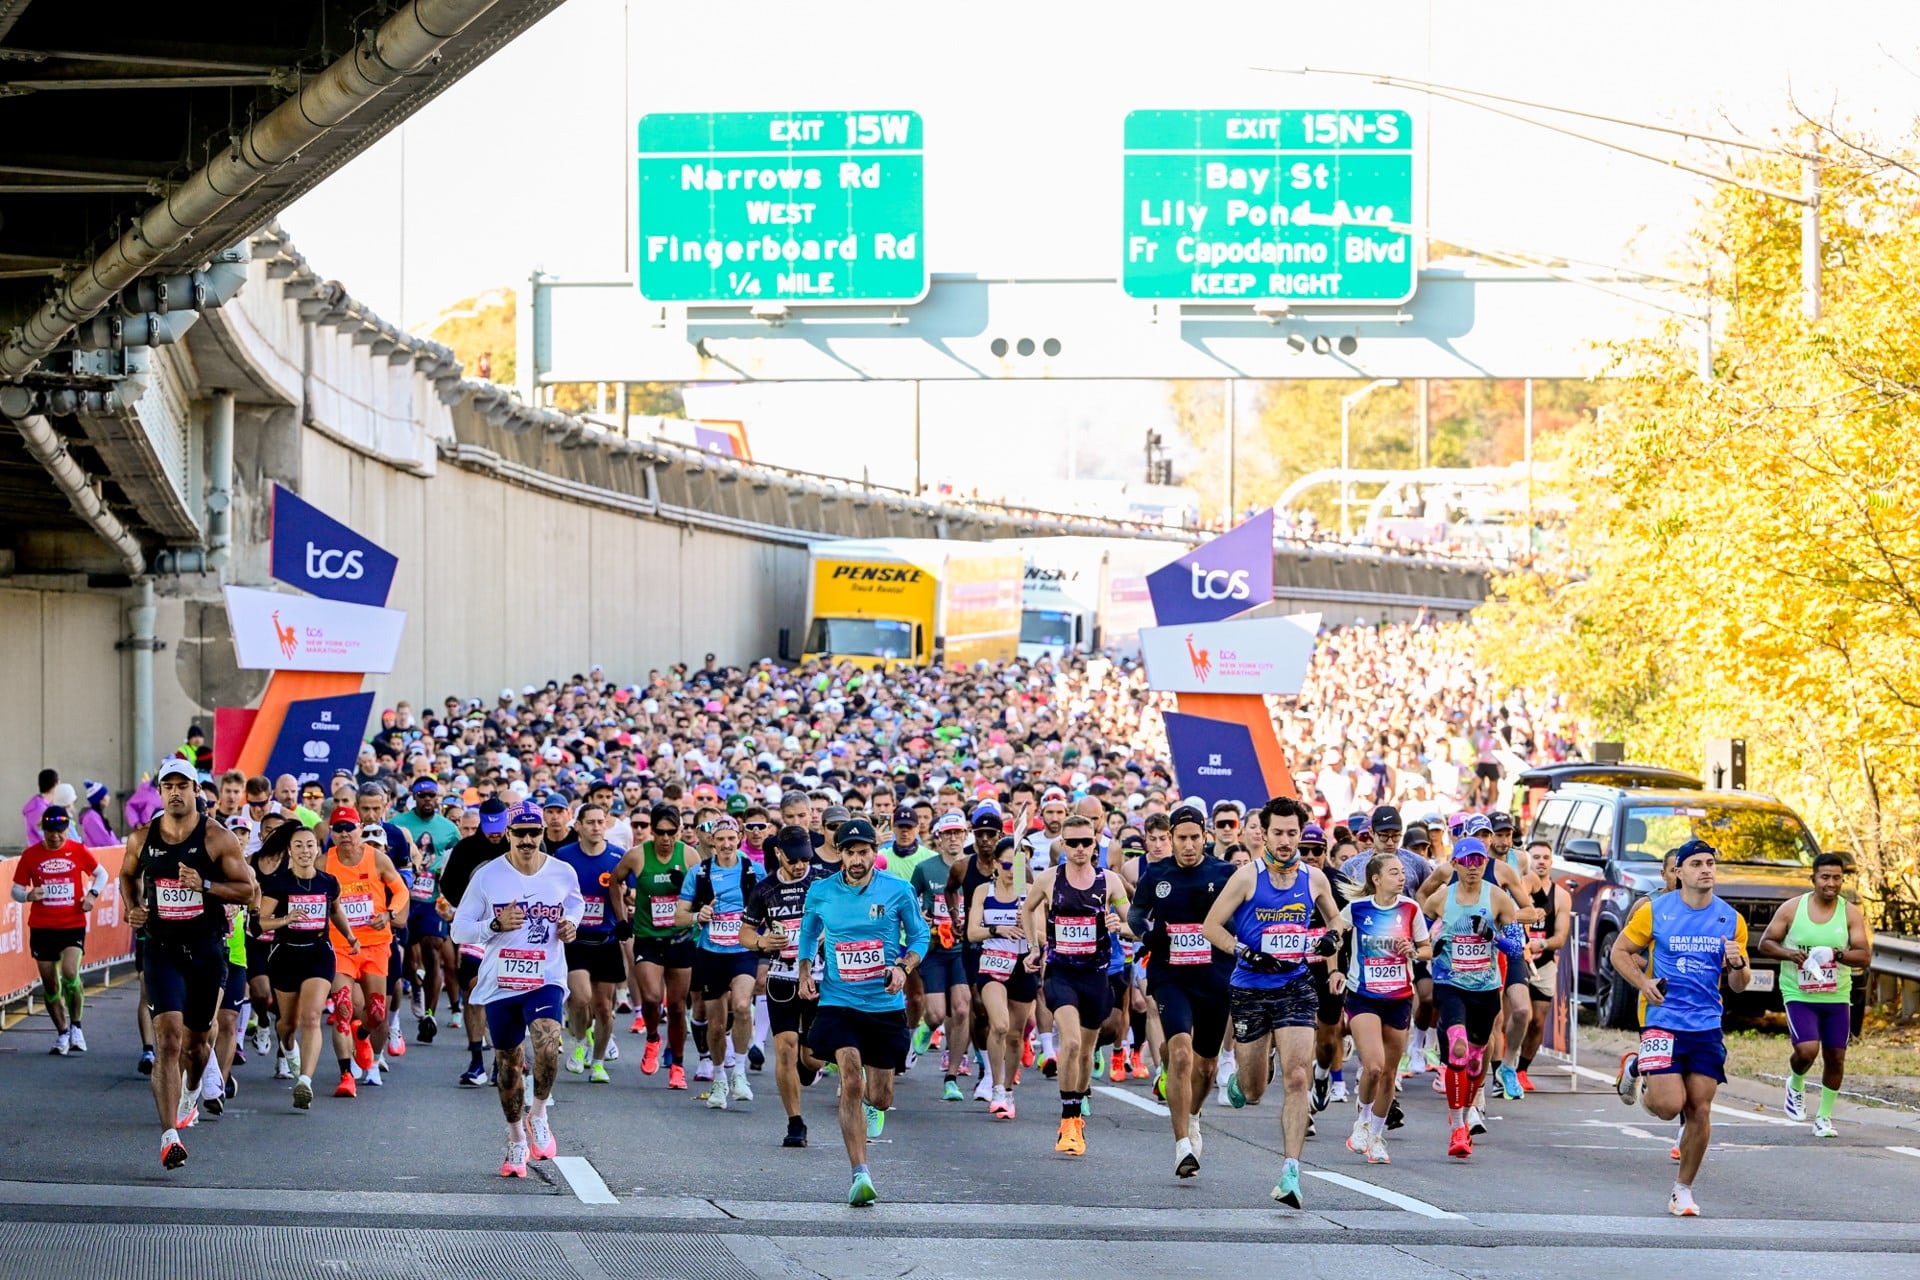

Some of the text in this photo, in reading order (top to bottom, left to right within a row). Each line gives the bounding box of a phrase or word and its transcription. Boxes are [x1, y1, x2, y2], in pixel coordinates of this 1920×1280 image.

[770, 115, 910, 144] EXIT 15W
[1226, 114, 1399, 144] EXIT 15N-S
[681, 162, 880, 190] Narrows Rd
[1206, 162, 1330, 195] Bay St
[746, 201, 816, 224] WEST
[1141, 199, 1394, 232] Lily Pond Ave
[647, 233, 916, 269] Fingerboard Rd
[1129, 236, 1405, 269] Fr Capodanno Blvd
[777, 272, 834, 293] MILE
[1191, 273, 1343, 295] KEEP RIGHT
[306, 541, 364, 580] tcs
[832, 566, 924, 583] PENSKE
[1191, 562, 1250, 600] tcs
[305, 639, 361, 648] NEW YORK CITY
[311, 721, 341, 731] Citizens
[1197, 766, 1233, 776] Citizens
[46, 885, 69, 895] 1025
[162, 889, 194, 902] 6307
[344, 903, 368, 914] 1001
[1255, 911, 1307, 922] WHIPPETS
[712, 920, 742, 932] 17698
[1062, 926, 1089, 938] 4314
[1173, 933, 1204, 947] 4038
[1270, 934, 1300, 948] 4126
[1669, 935, 1721, 946] GRAY NATION
[1457, 944, 1486, 956] 6362
[1669, 943, 1721, 954] ENDURANCE
[841, 950, 880, 965] 17436
[984, 956, 1010, 970] 7892
[504, 959, 539, 974] 17521
[1369, 965, 1402, 978] 19261
